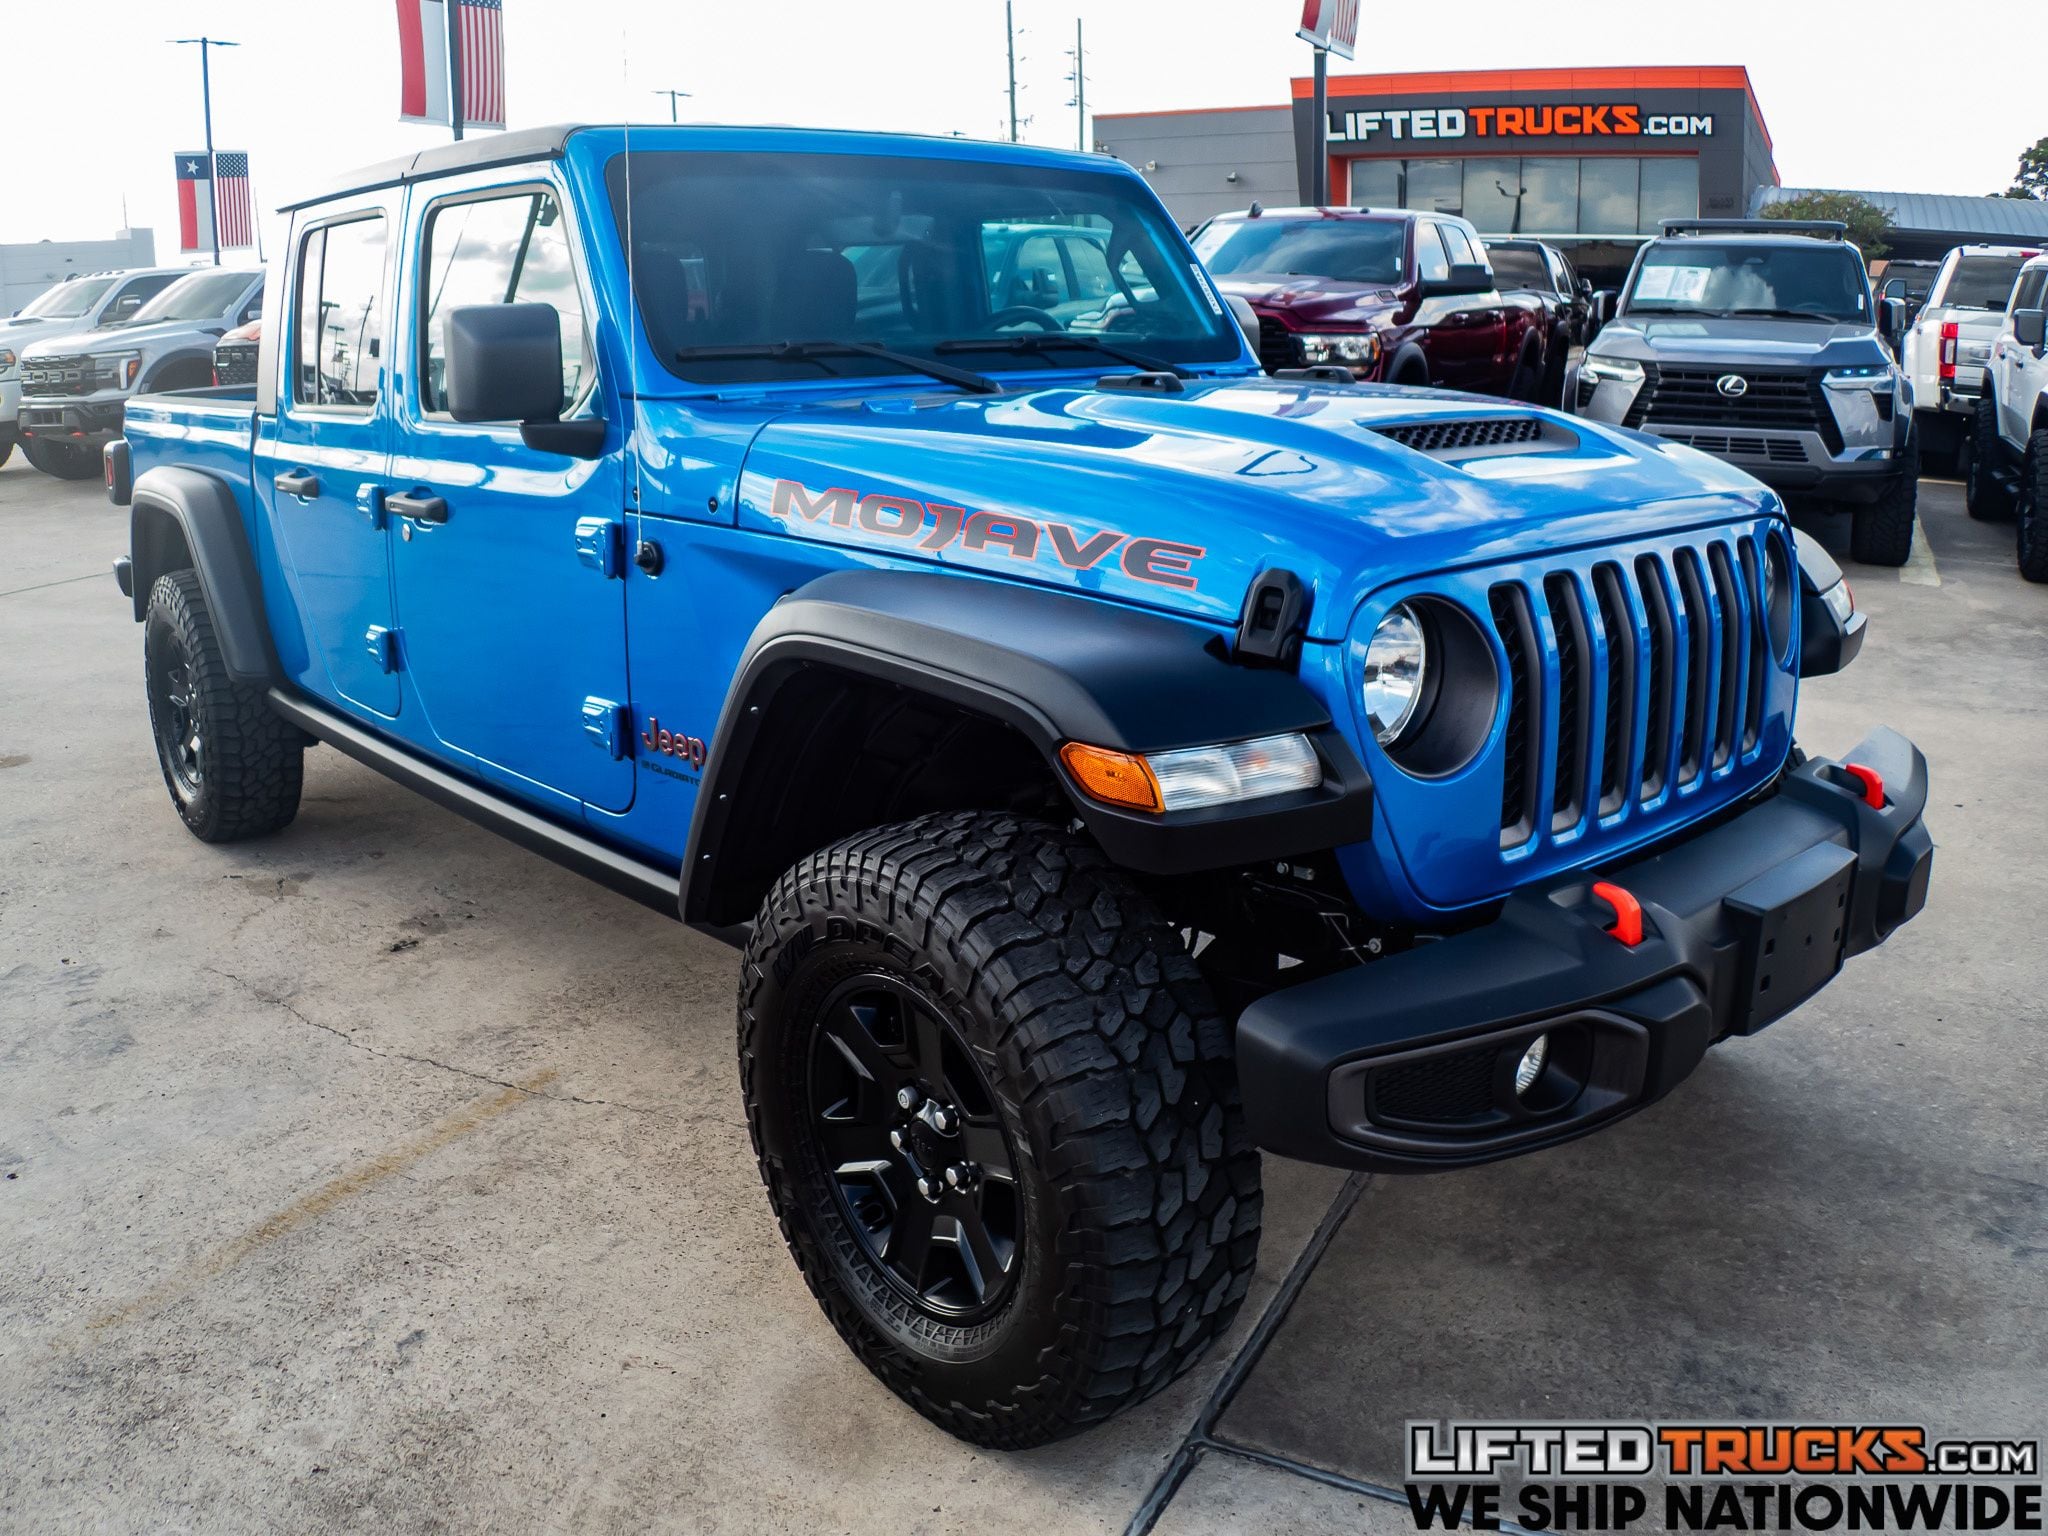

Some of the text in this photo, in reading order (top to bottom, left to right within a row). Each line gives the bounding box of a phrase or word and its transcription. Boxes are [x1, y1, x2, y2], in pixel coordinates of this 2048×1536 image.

[770, 479, 1206, 591] MOJAVE
[641, 716, 706, 772] Jeep
[651, 762, 701, 787] GLADIATO
